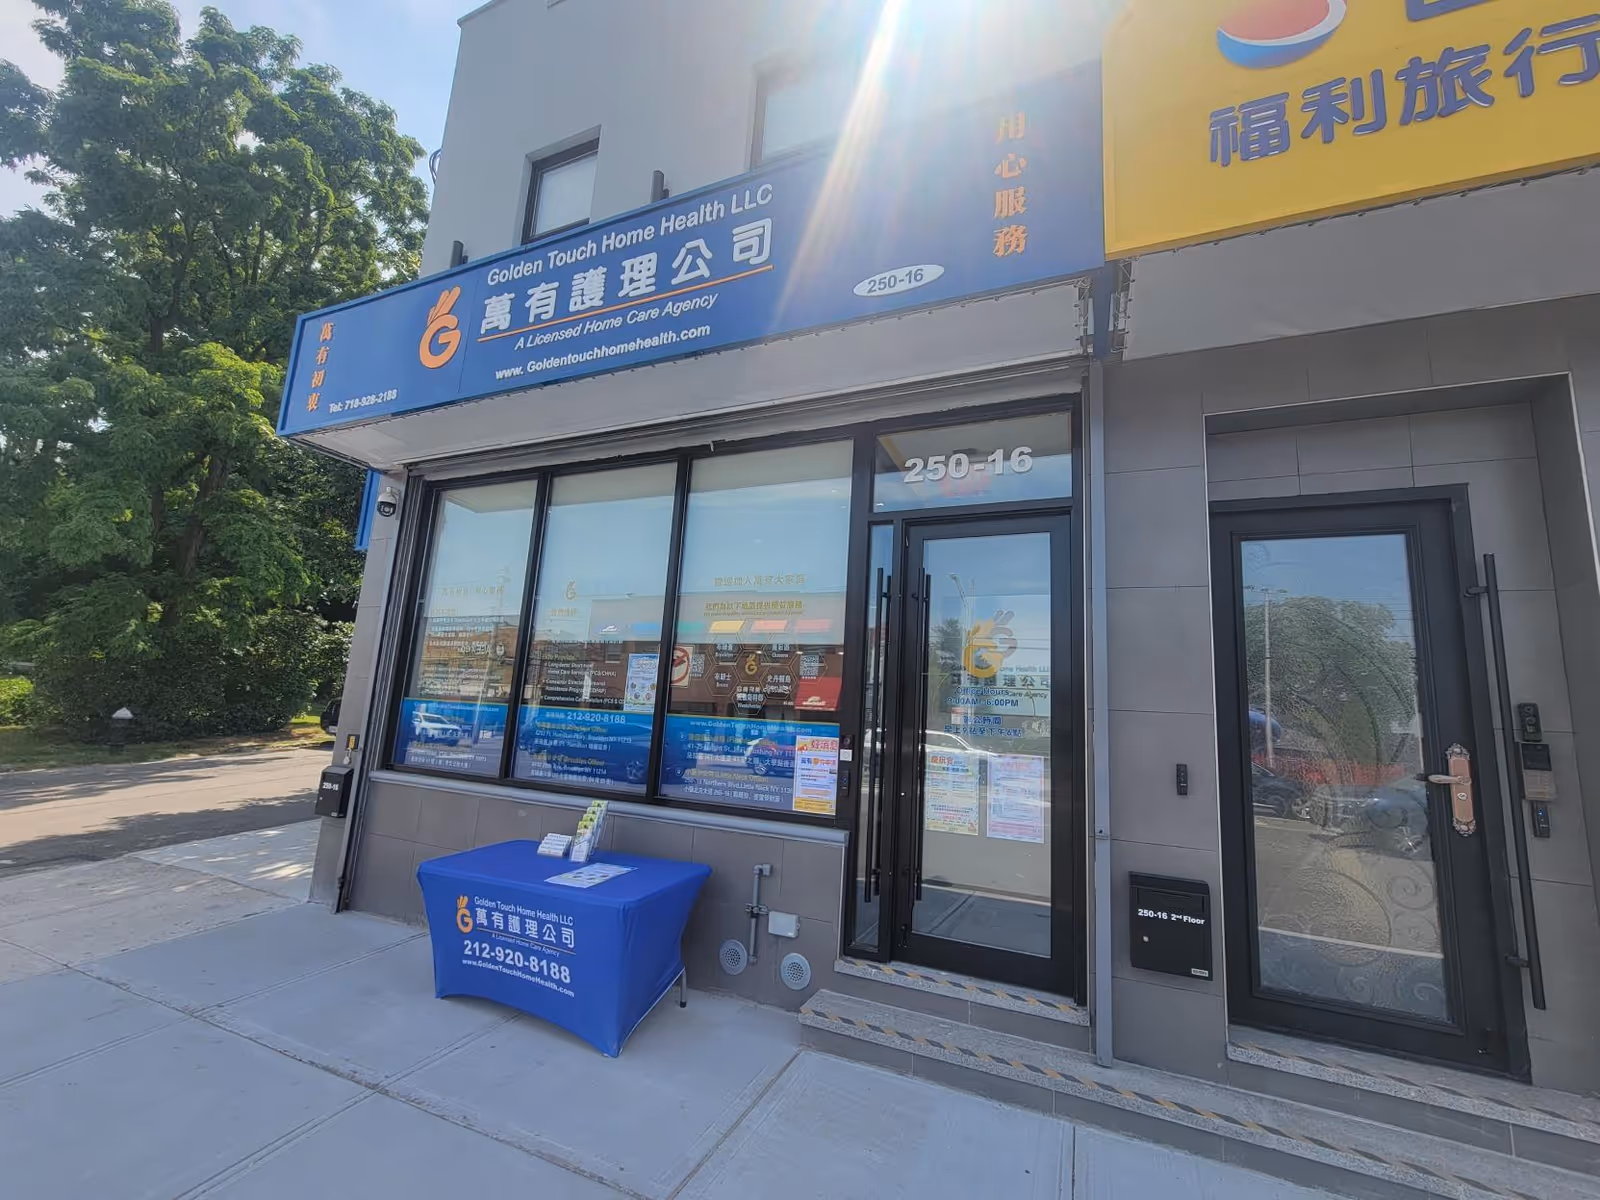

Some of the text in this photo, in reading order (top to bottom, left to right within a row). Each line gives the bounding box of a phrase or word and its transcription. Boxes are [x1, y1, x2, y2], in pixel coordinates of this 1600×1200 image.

[1209, 13, 1600, 168] 福利旅行
[992, 110, 1028, 258] 用心服務
[487, 183, 773, 286] Golden Touch Home Health LLC
[480, 217, 773, 335] 萬有護理公司
[866, 268, 925, 294] 250-16
[514, 293, 719, 351] A Licensed Home Care Agency
[495, 324, 711, 381] www. Goldentouchhomehealth.com
[903, 446, 1033, 483] 250-16
[982, 687, 1010, 696] Hours
[986, 699, 1019, 707] 6:00PM
[566, 712, 626, 724] 212-920-8188
[474, 896, 574, 926] Golden Touch Home Health LLC
[475, 907, 575, 949] 萬有護理公司
[1138, 908, 1168, 920] 250-16
[1183, 915, 1206, 925] Floor
[462, 959, 575, 998] www.GoldenTouchHomeHealth.com
[463, 939, 571, 984] 212-920-8188
